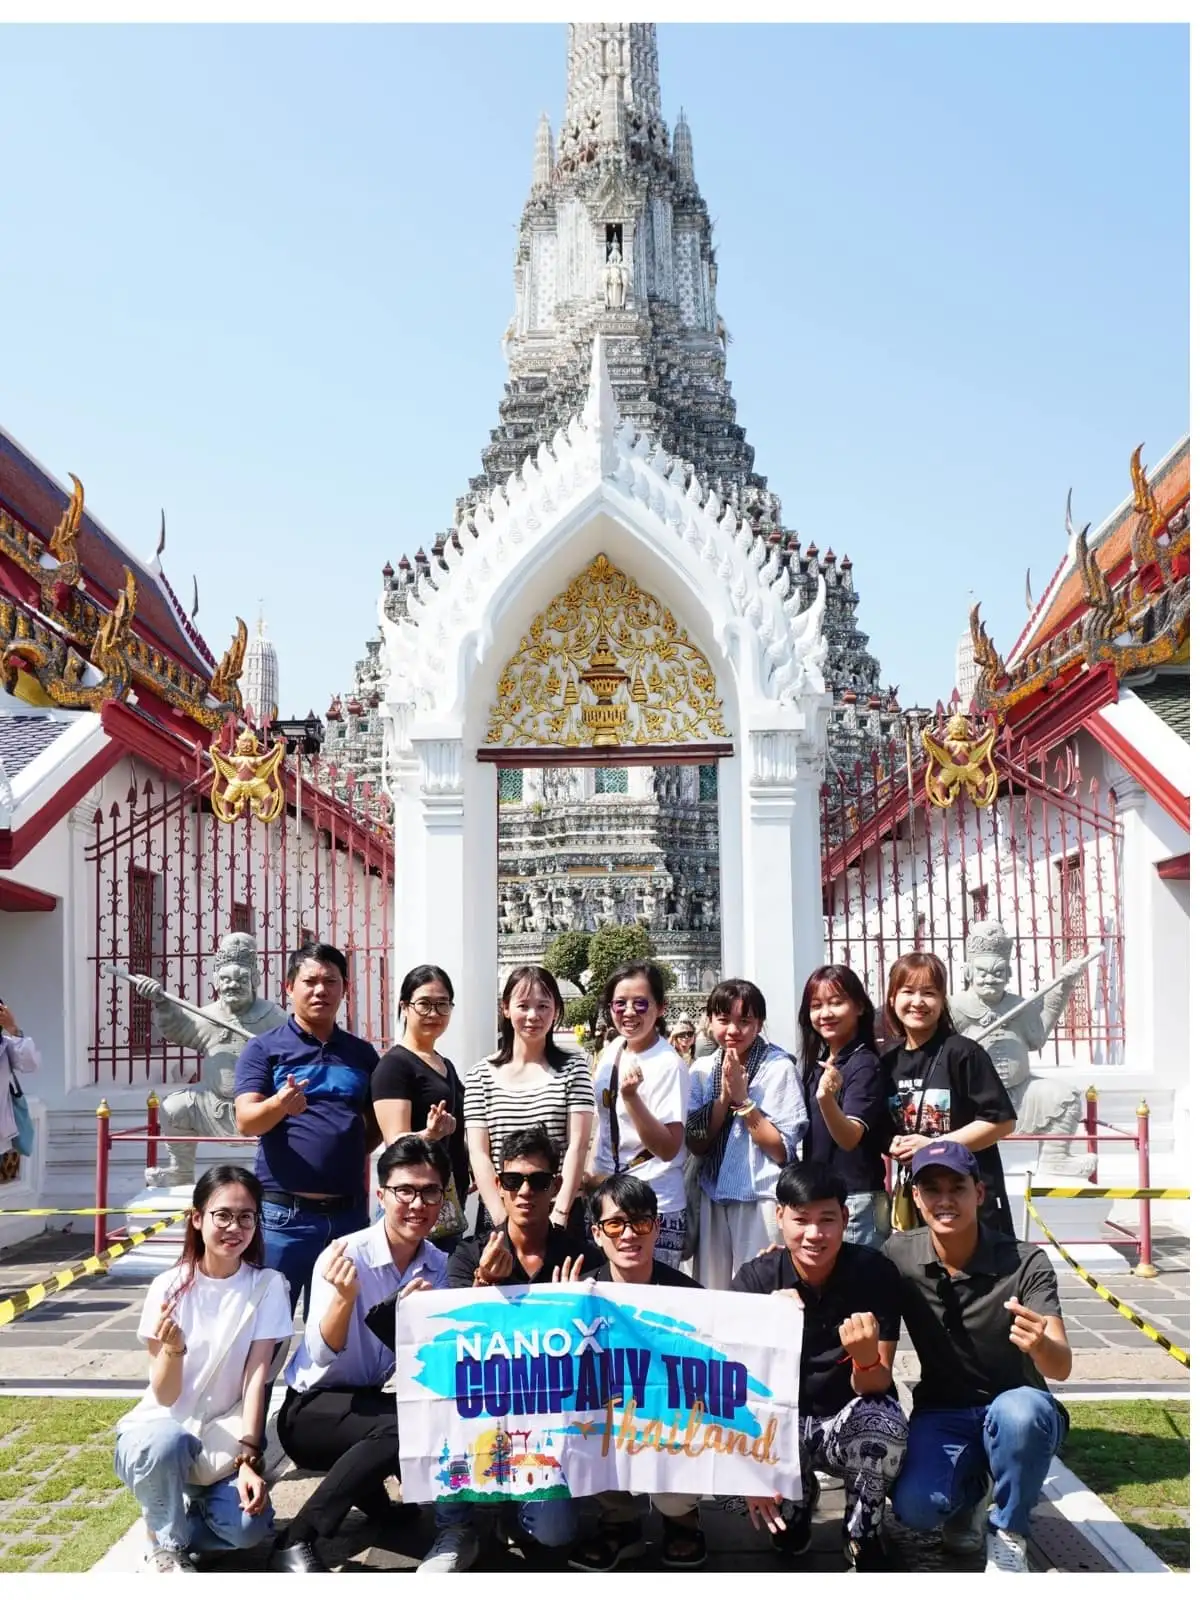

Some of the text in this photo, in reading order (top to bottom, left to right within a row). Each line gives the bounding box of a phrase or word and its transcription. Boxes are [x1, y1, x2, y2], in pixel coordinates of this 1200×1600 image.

[457, 1317, 605, 1362] NANOX
[454, 1347, 748, 1421] COMPANY TRIP
[600, 1393, 781, 1466] Thailand
